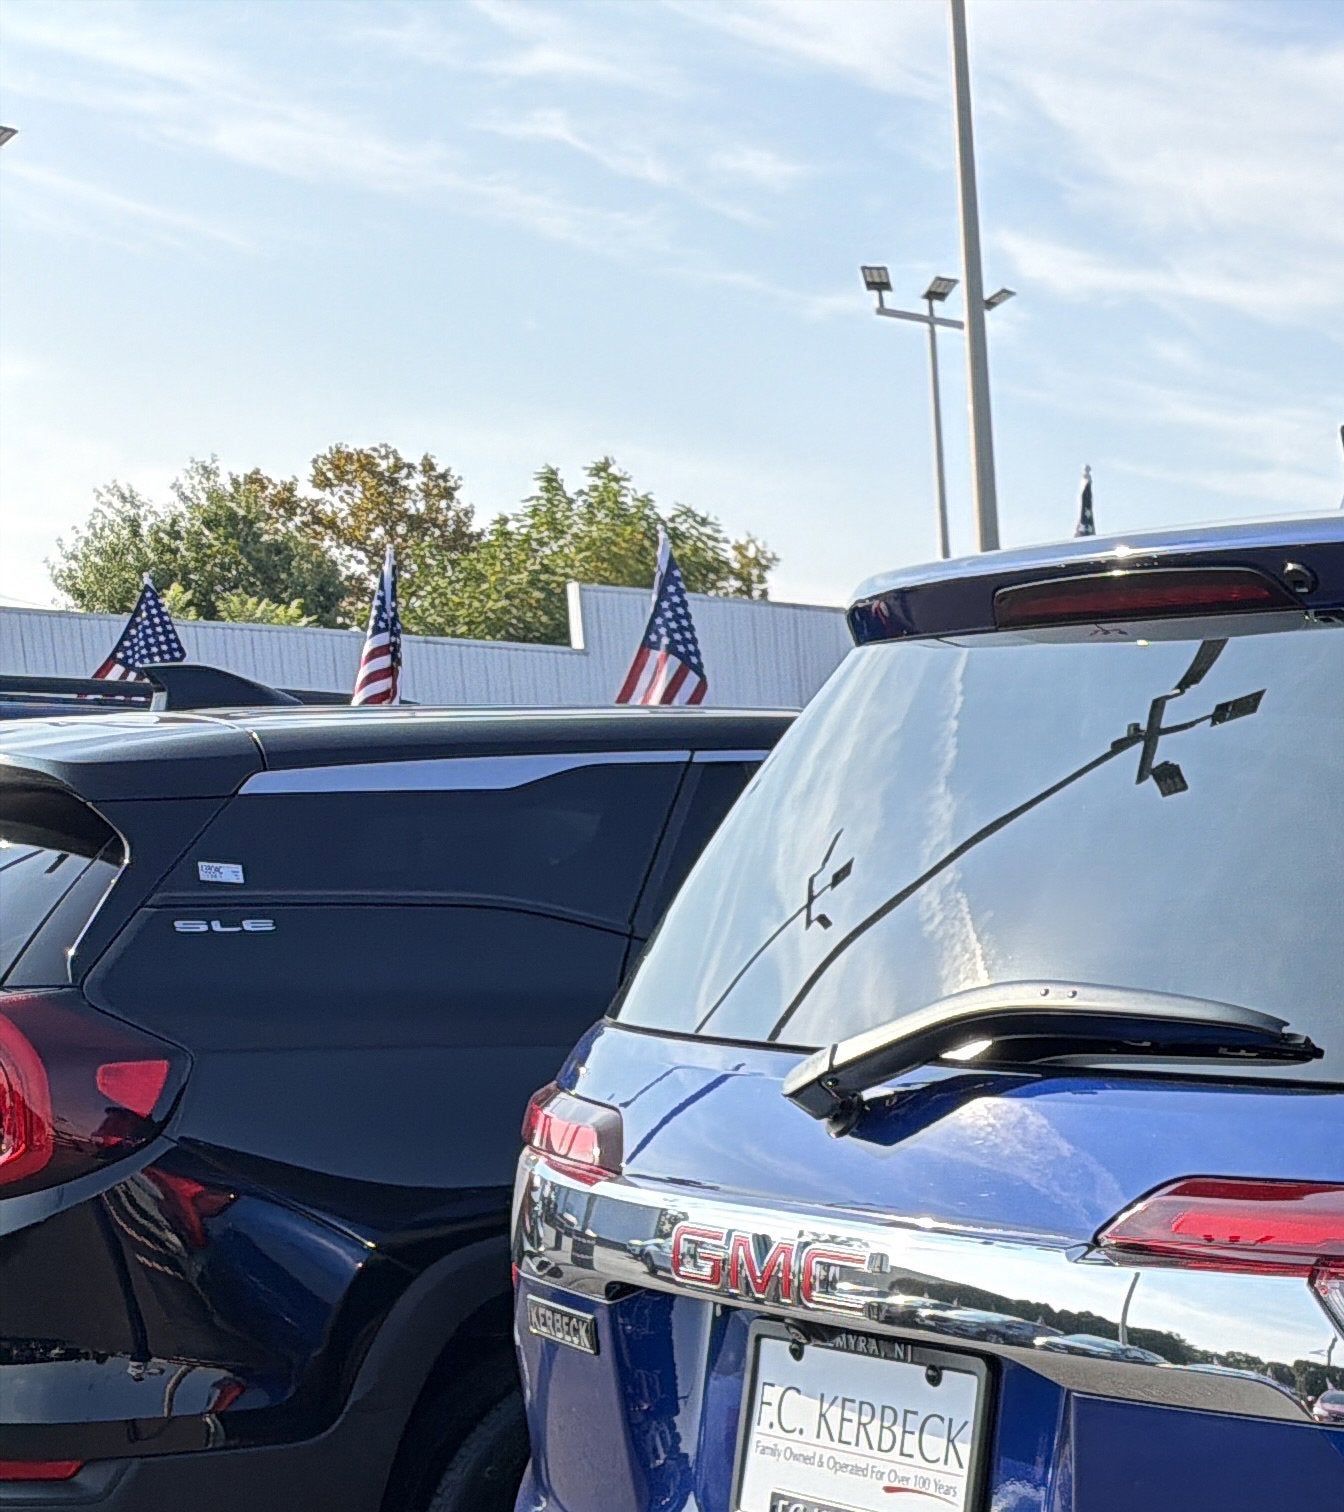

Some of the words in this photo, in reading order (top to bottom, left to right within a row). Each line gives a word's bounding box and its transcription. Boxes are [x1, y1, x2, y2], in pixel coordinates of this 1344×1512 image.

[173, 919, 276, 932] SLE
[672, 1221, 878, 1317] GMC
[530, 1305, 591, 1349] KERBECK
[757, 1381, 804, 1436] F.C.
[815, 1392, 969, 1469] KERBECK
[755, 1440, 781, 1462] Family
[783, 1447, 815, 1466] Owned
[817, 1454, 824, 1468] &
[826, 1456, 868, 1478] Operated
[870, 1467, 886, 1483] For
[887, 1469, 911, 1487] Over
[913, 1475, 931, 1490] 100
[933, 1478, 958, 1498] Years
